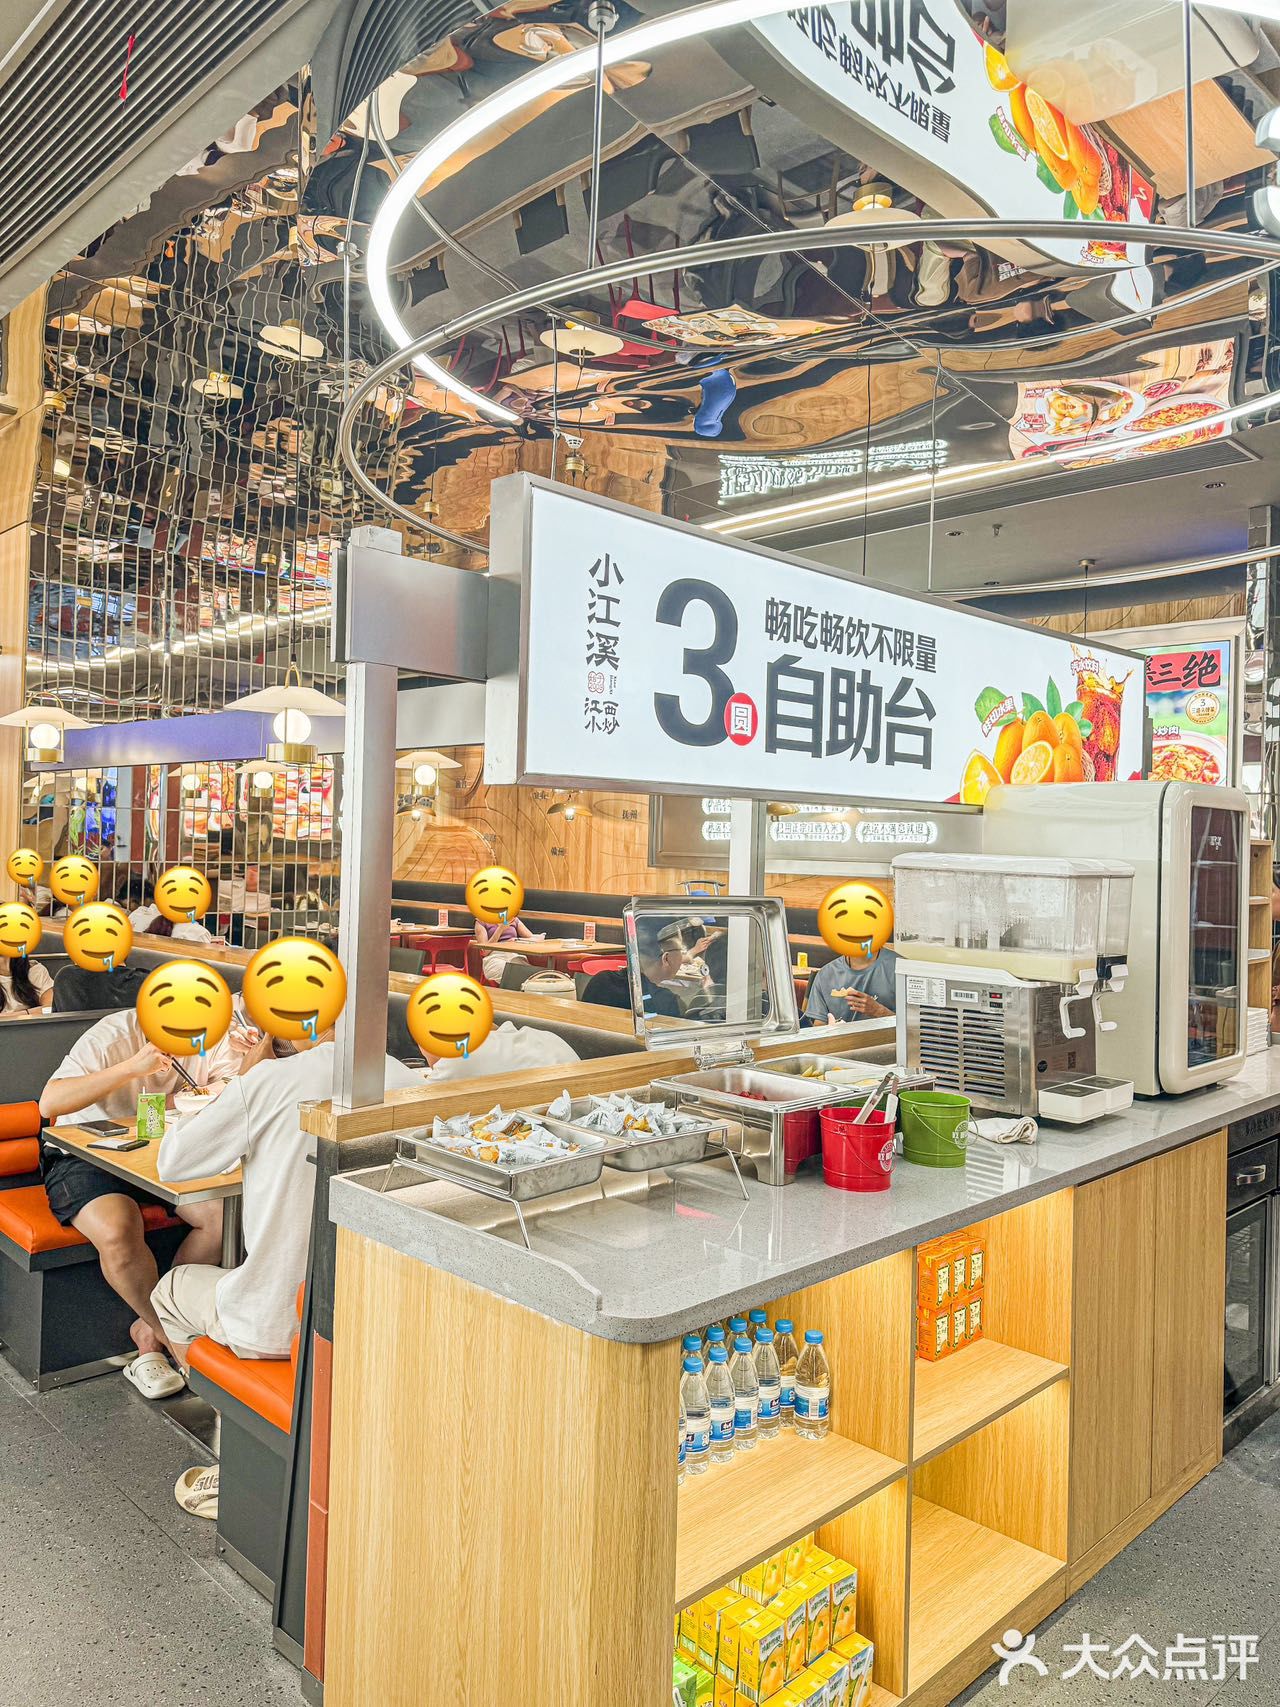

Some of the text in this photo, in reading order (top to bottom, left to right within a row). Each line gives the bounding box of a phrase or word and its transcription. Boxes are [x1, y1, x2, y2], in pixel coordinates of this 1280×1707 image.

[586, 553, 624, 671] 小江溪
[653, 578, 739, 747] 3
[764, 596, 938, 674] 畅吃畅饮不限量
[764, 654, 937, 769] 自助台
[1153, 724, 1180, 736] 炒肉
